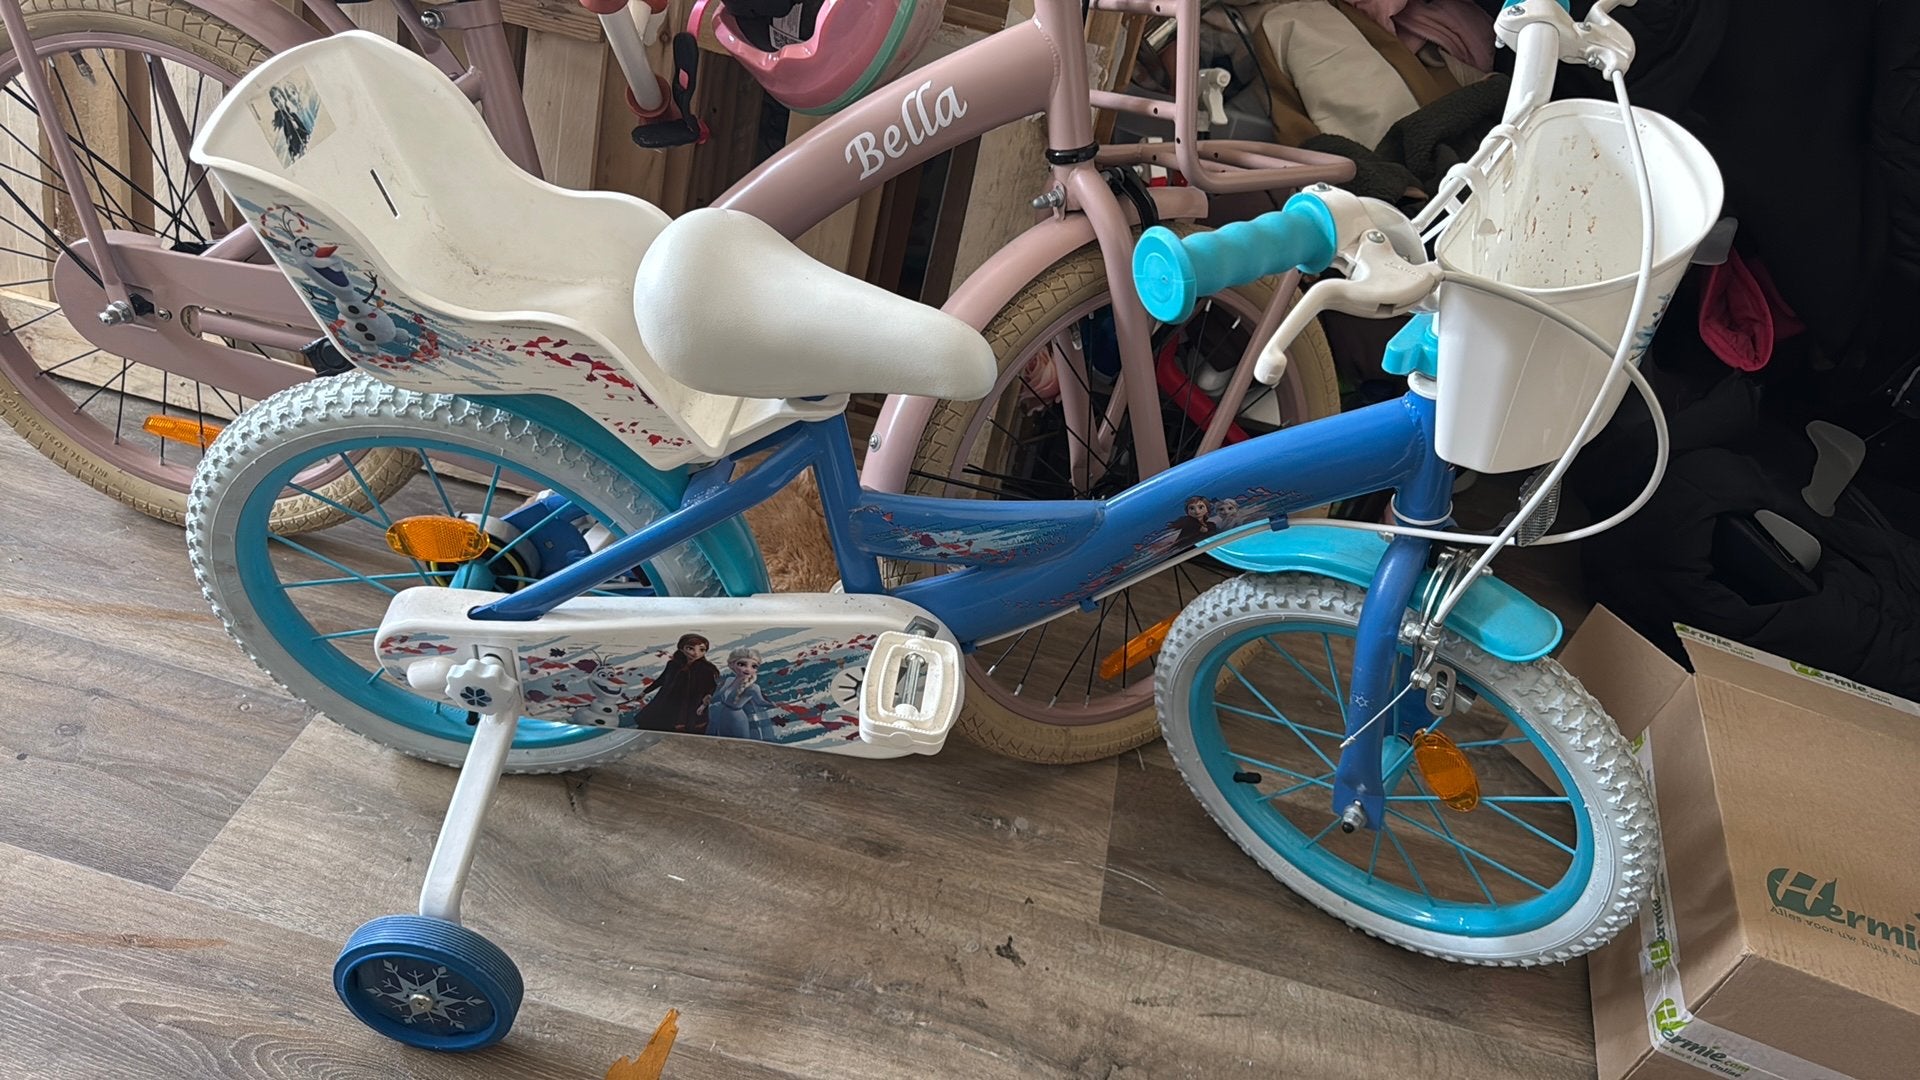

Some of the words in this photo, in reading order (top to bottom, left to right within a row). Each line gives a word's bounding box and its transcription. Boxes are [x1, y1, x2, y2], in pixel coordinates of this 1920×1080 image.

[845, 80, 967, 181] Bella
[1767, 868, 1920, 951] Hermi
[1770, 906, 1802, 922] Alles
[1805, 919, 1834, 934] voor
